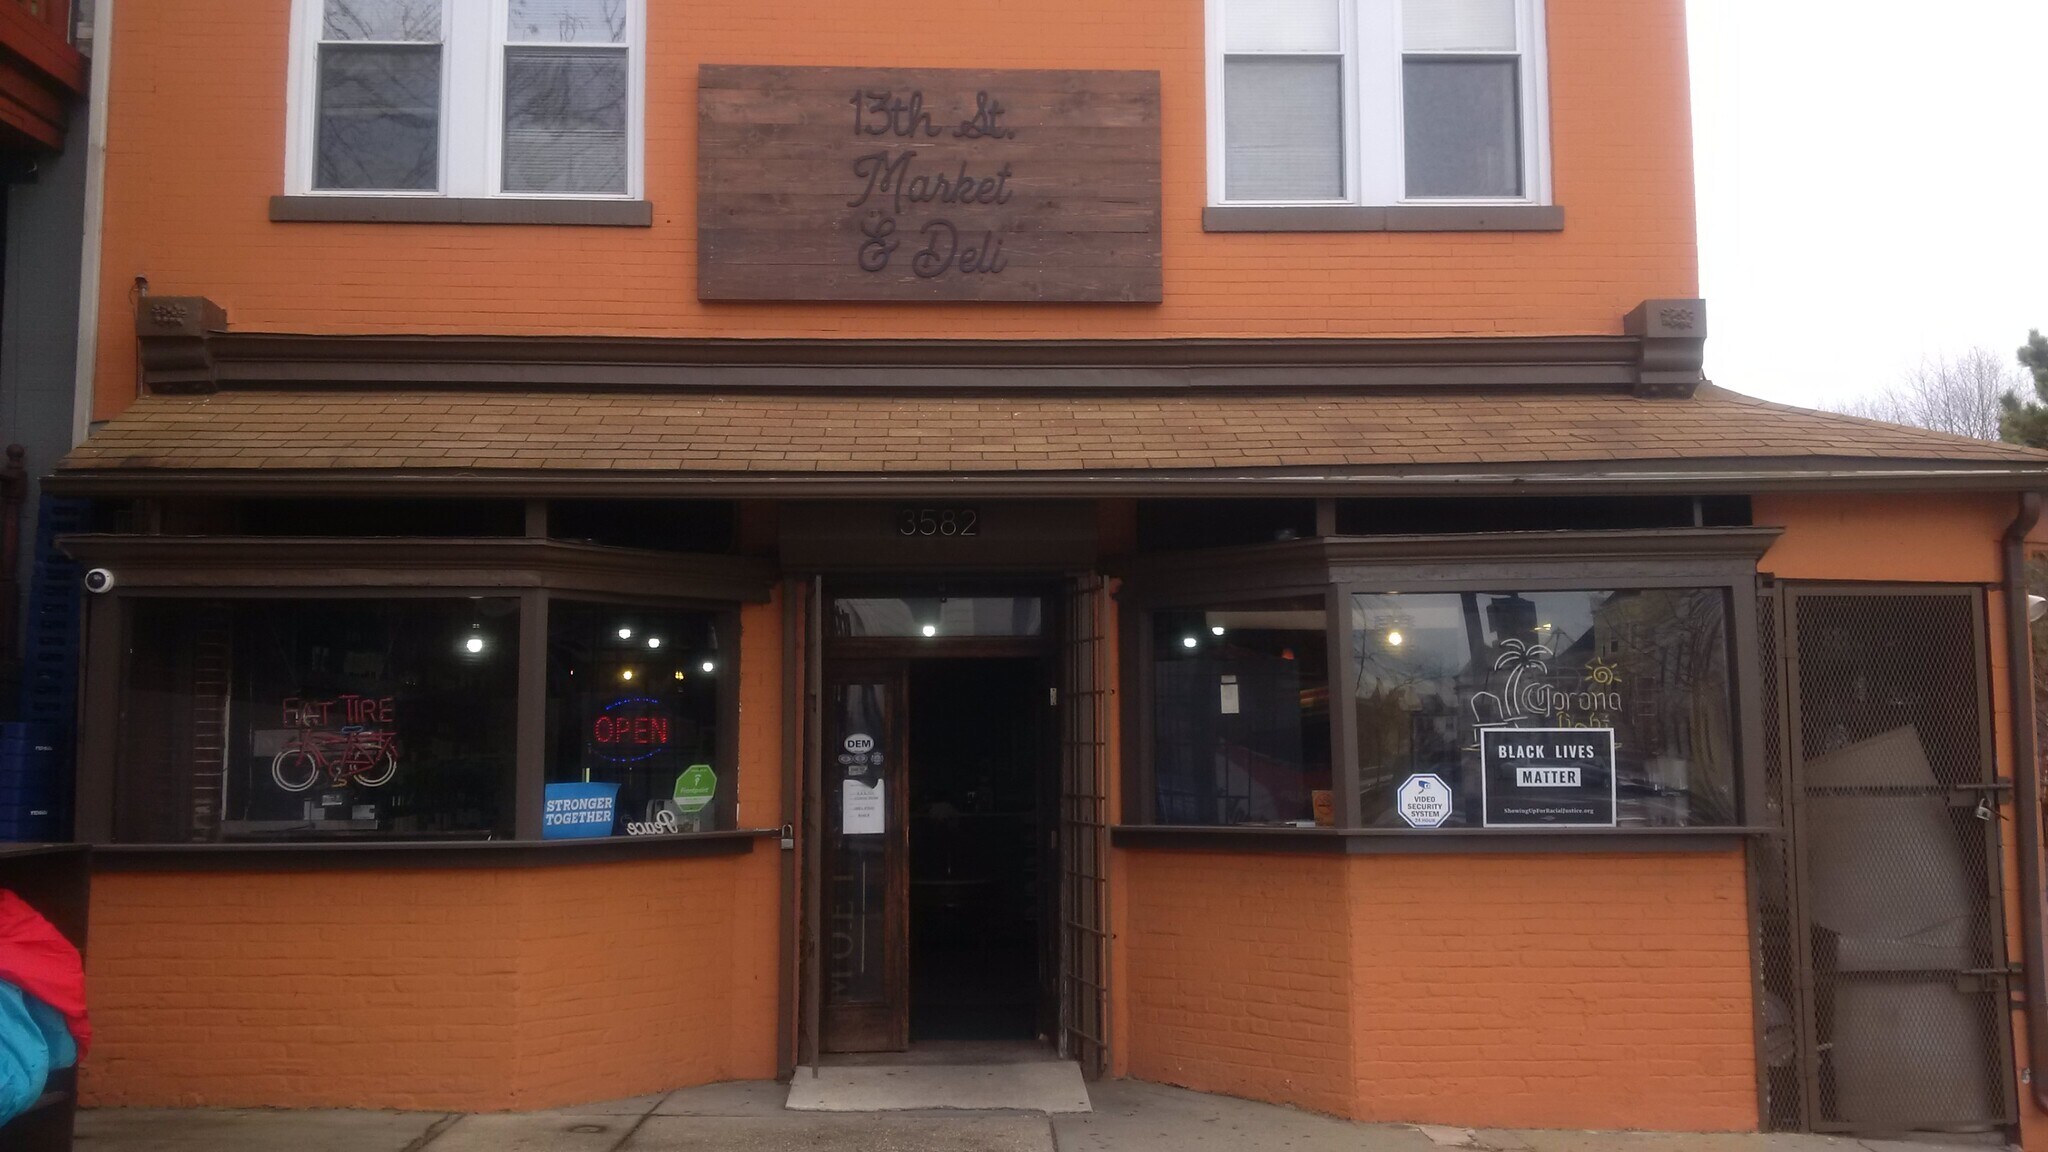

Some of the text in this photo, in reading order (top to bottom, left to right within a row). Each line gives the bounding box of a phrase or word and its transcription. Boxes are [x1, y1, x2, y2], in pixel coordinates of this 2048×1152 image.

[850, 88, 1016, 140] 13th St.
[846, 150, 1014, 214] Market
[857, 217, 1007, 279] & Deli
[900, 508, 977, 536] 3582
[282, 694, 394, 728] FAT TIRE
[1521, 682, 1623, 718] Corona
[594, 715, 668, 744] OPEN
[847, 739, 871, 749] DEM
[1498, 744, 1595, 759] BLACK LIVES
[1522, 770, 1576, 784] MATTER
[545, 810, 612, 826] TOGETHER
[546, 796, 613, 813] STRONGER
[1411, 810, 1440, 818] SYSTEM
